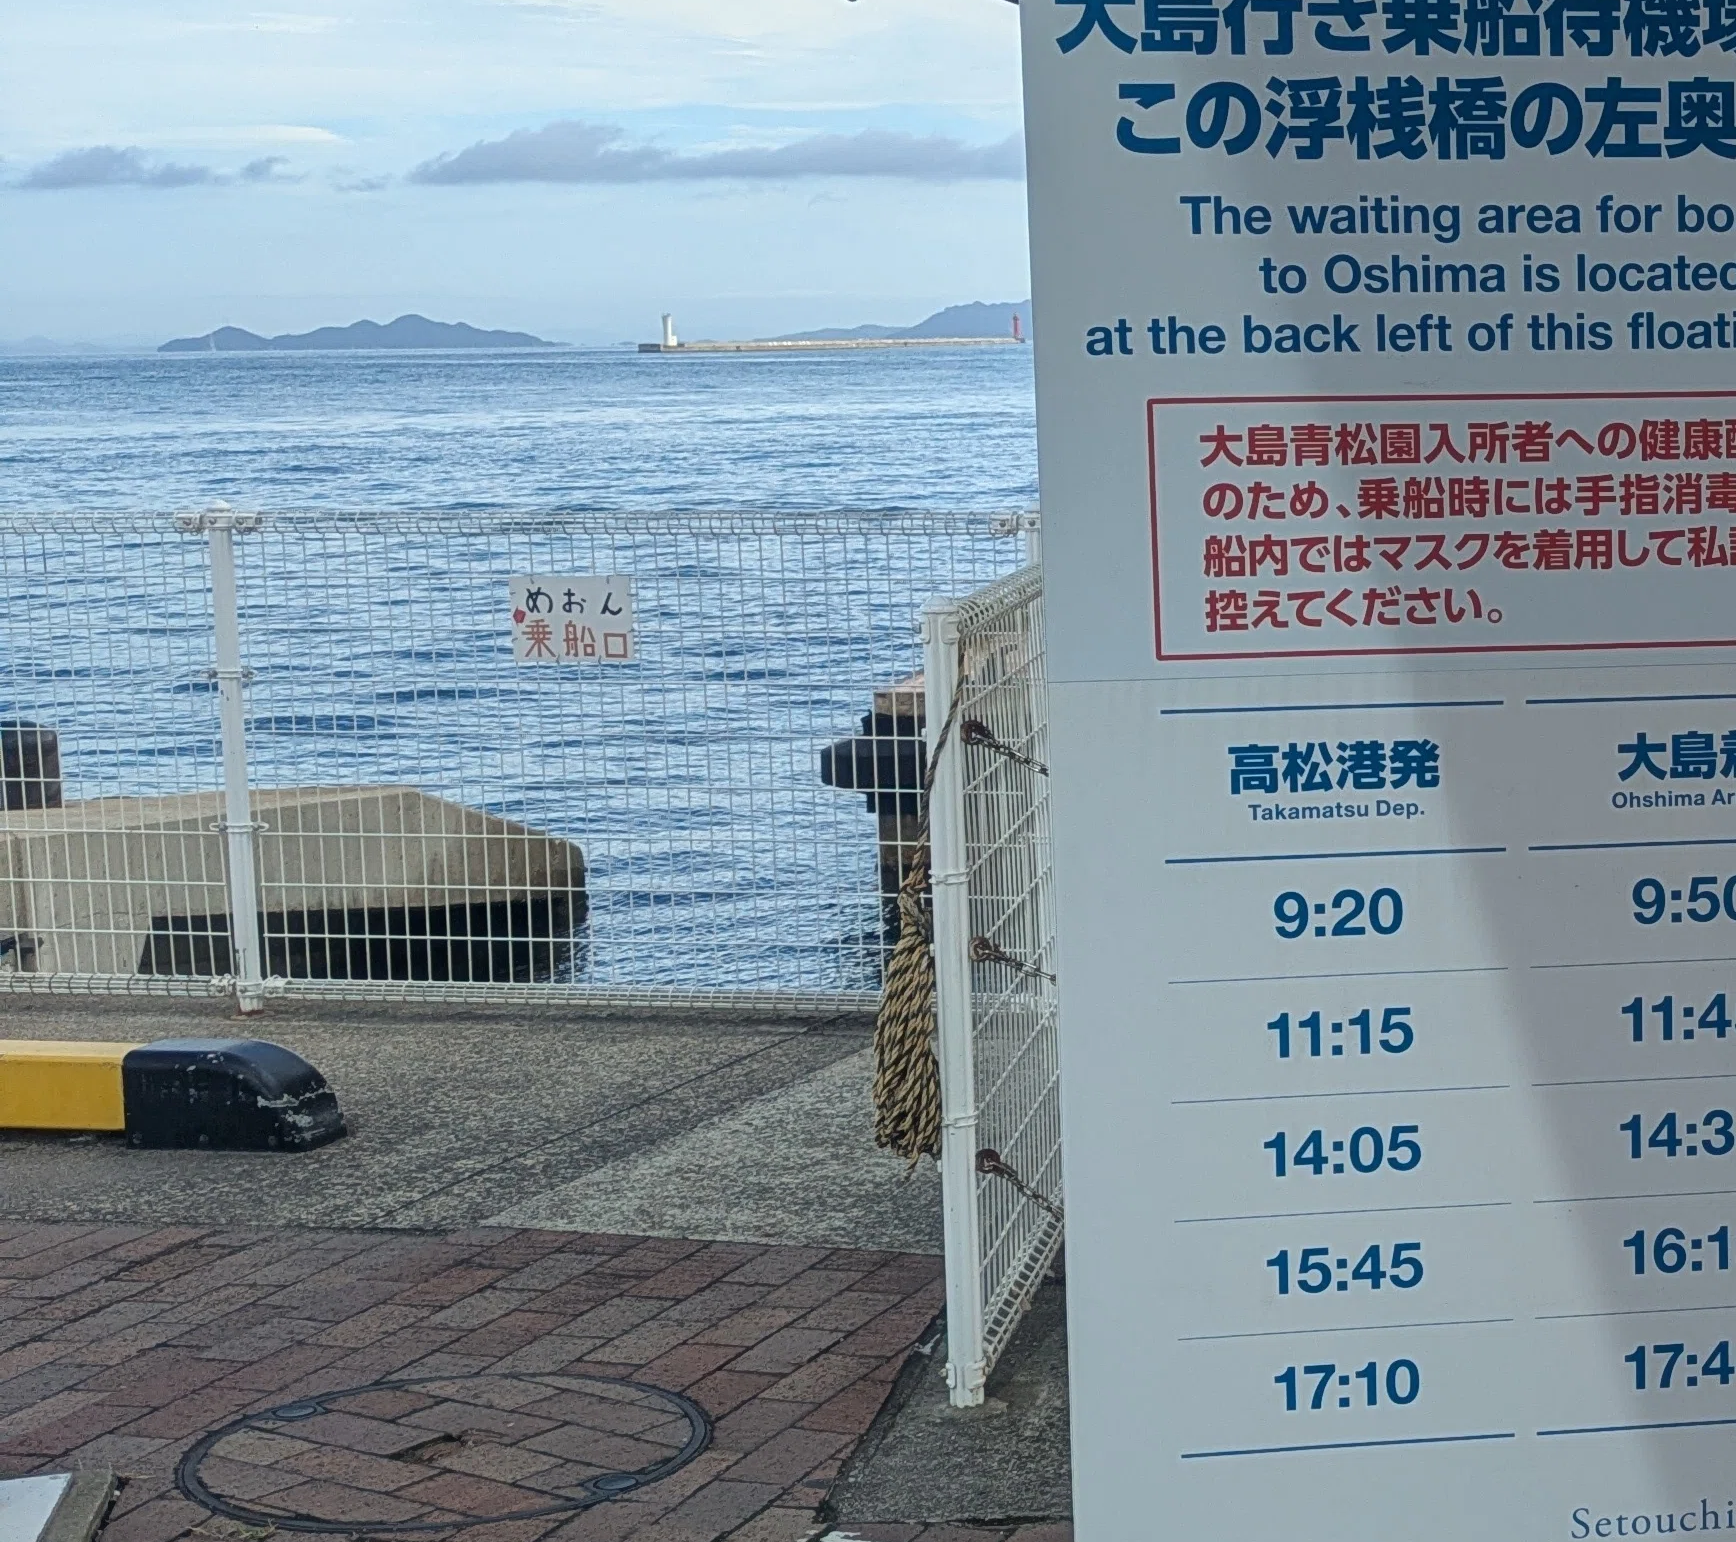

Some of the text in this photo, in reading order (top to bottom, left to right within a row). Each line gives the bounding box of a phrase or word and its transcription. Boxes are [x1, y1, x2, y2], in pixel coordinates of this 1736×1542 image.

[1179, 195, 1272, 235] The
[1286, 194, 1461, 244] waiting
[1477, 204, 1581, 234] area
[1595, 194, 1663, 234] for
[1258, 257, 1307, 294] to
[1324, 253, 1506, 294] Oshima
[1523, 253, 1561, 293] is
[1085, 318, 1134, 356] at
[1146, 315, 1227, 355] the
[1243, 313, 1361, 354] back
[1376, 313, 1453, 353] left
[1467, 312, 1514, 352] of
[1526, 312, 1613, 351] this
[525, 586, 623, 616] めおん
[1205, 587, 1504, 633] 控えてください。
[521, 618, 629, 659] 乗船口
[1227, 738, 1441, 795] 高松港発
[1247, 799, 1426, 821] Takamatsu Dep.
[1611, 790, 1706, 809] Ohshima
[1273, 887, 1404, 939] 9:20
[1267, 1006, 1414, 1059] 11:15
[1263, 1124, 1422, 1178] 14:05
[1266, 1241, 1424, 1295] 15:45
[1274, 1358, 1420, 1412] 17:10
[1570, 1498, 1736, 1540] Setouchi
